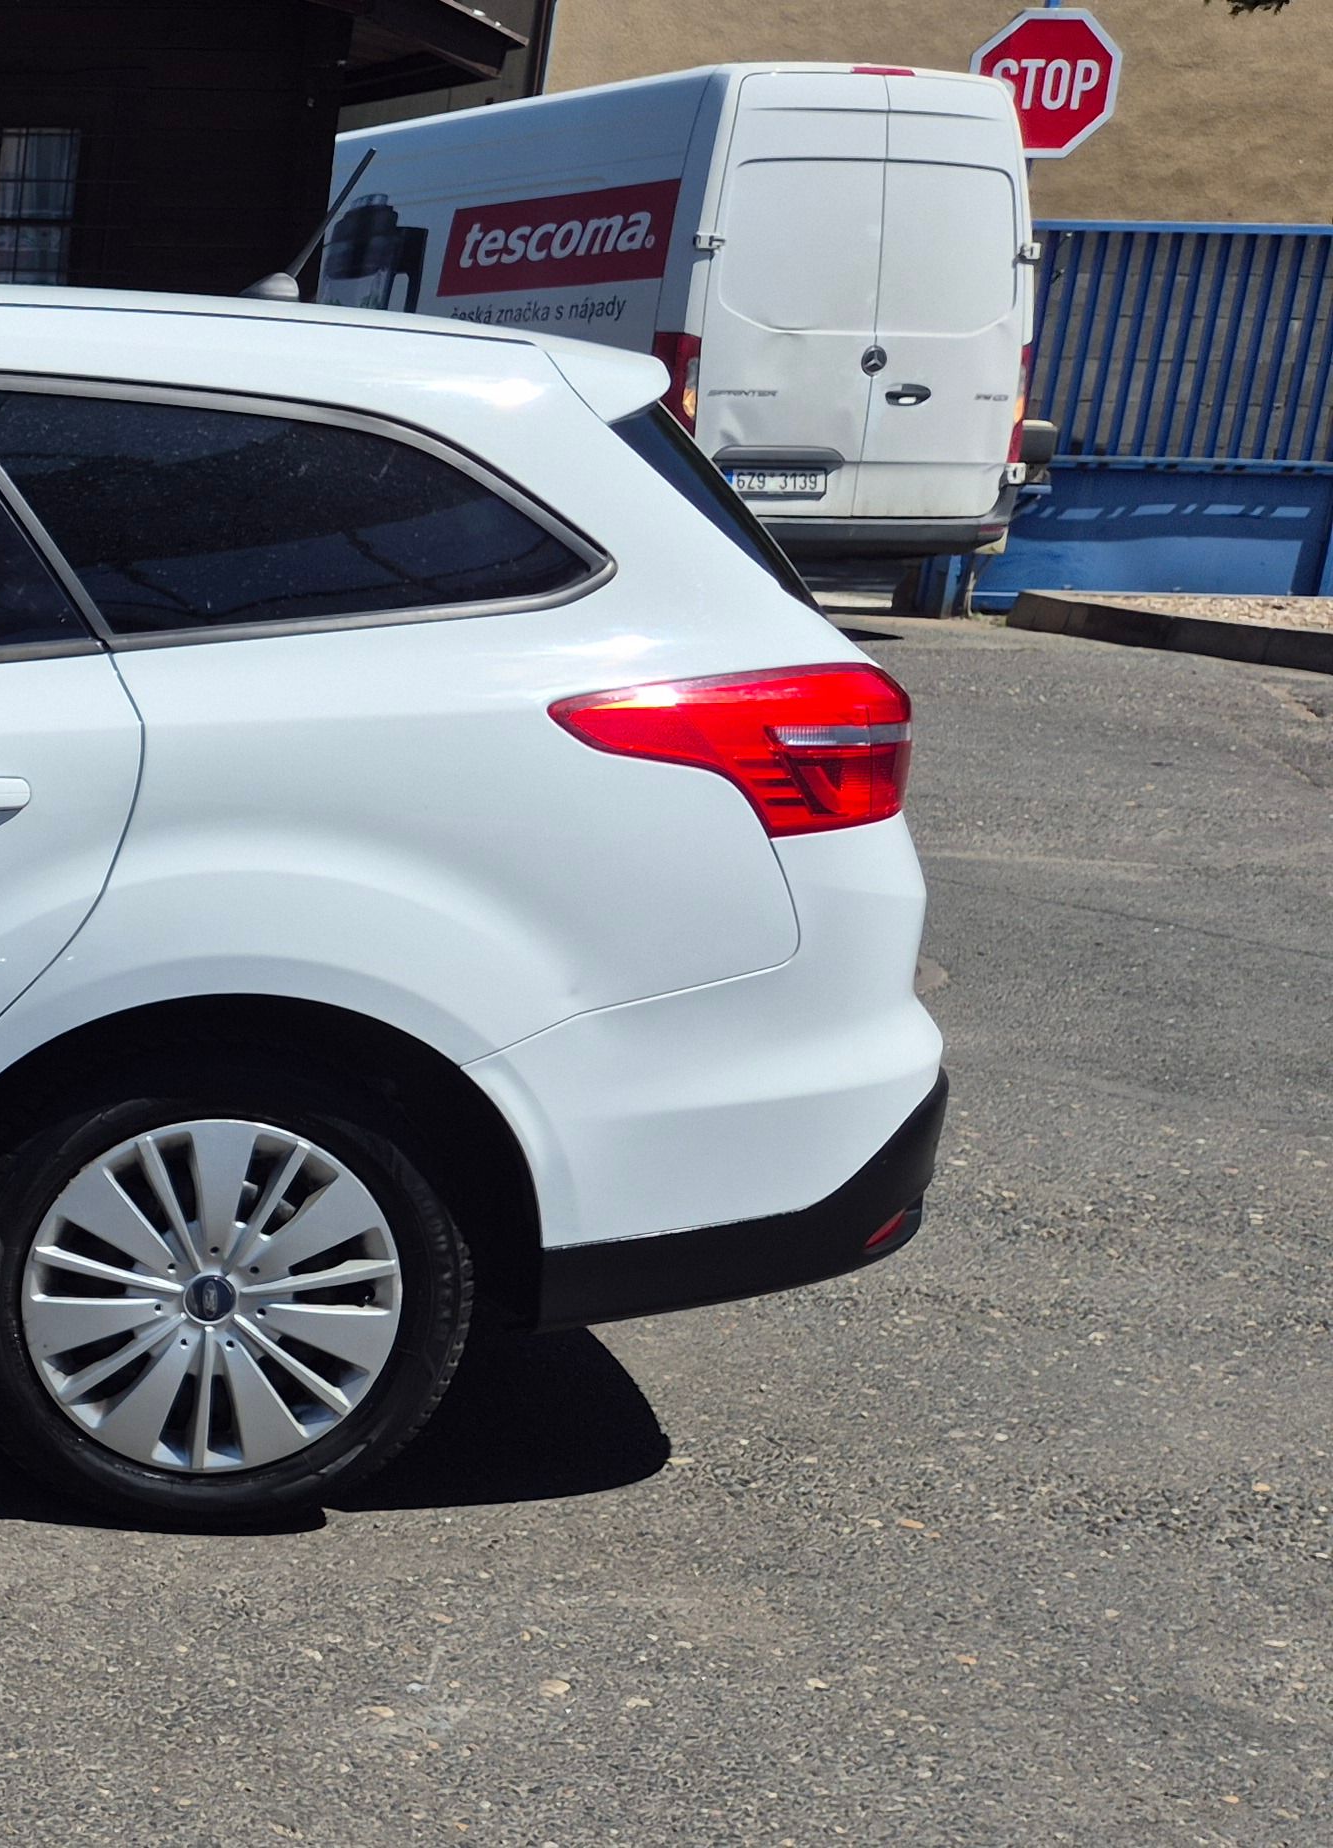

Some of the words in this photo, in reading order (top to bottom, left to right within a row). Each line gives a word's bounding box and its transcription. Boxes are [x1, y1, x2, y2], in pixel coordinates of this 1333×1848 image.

[992, 58, 1100, 111] STOP
[495, 302, 550, 324] značka
[555, 309, 564, 320] s
[736, 472, 767, 490] 6Z9
[778, 473, 818, 491] 3139
